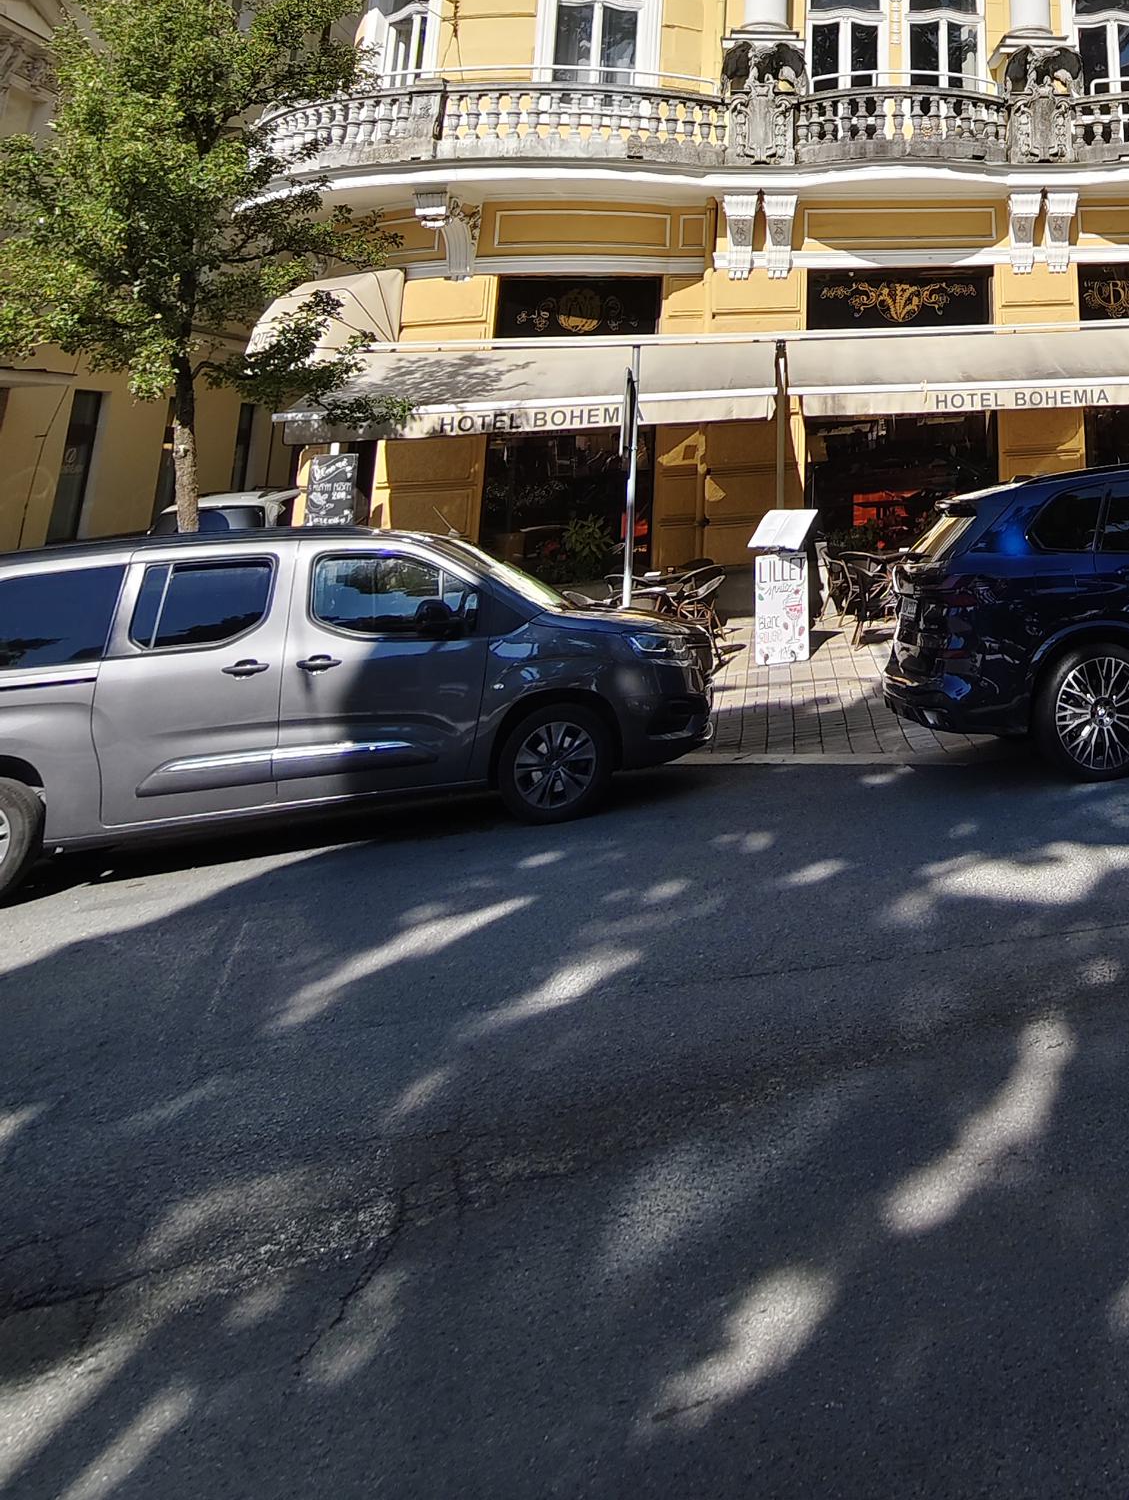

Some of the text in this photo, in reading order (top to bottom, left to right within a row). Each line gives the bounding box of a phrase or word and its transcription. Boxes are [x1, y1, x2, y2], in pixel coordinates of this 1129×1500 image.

[935, 389, 1109, 410] HOTEL BOHEMIA
[440, 412, 522, 433] HOTEL
[759, 557, 805, 583] LILLET
